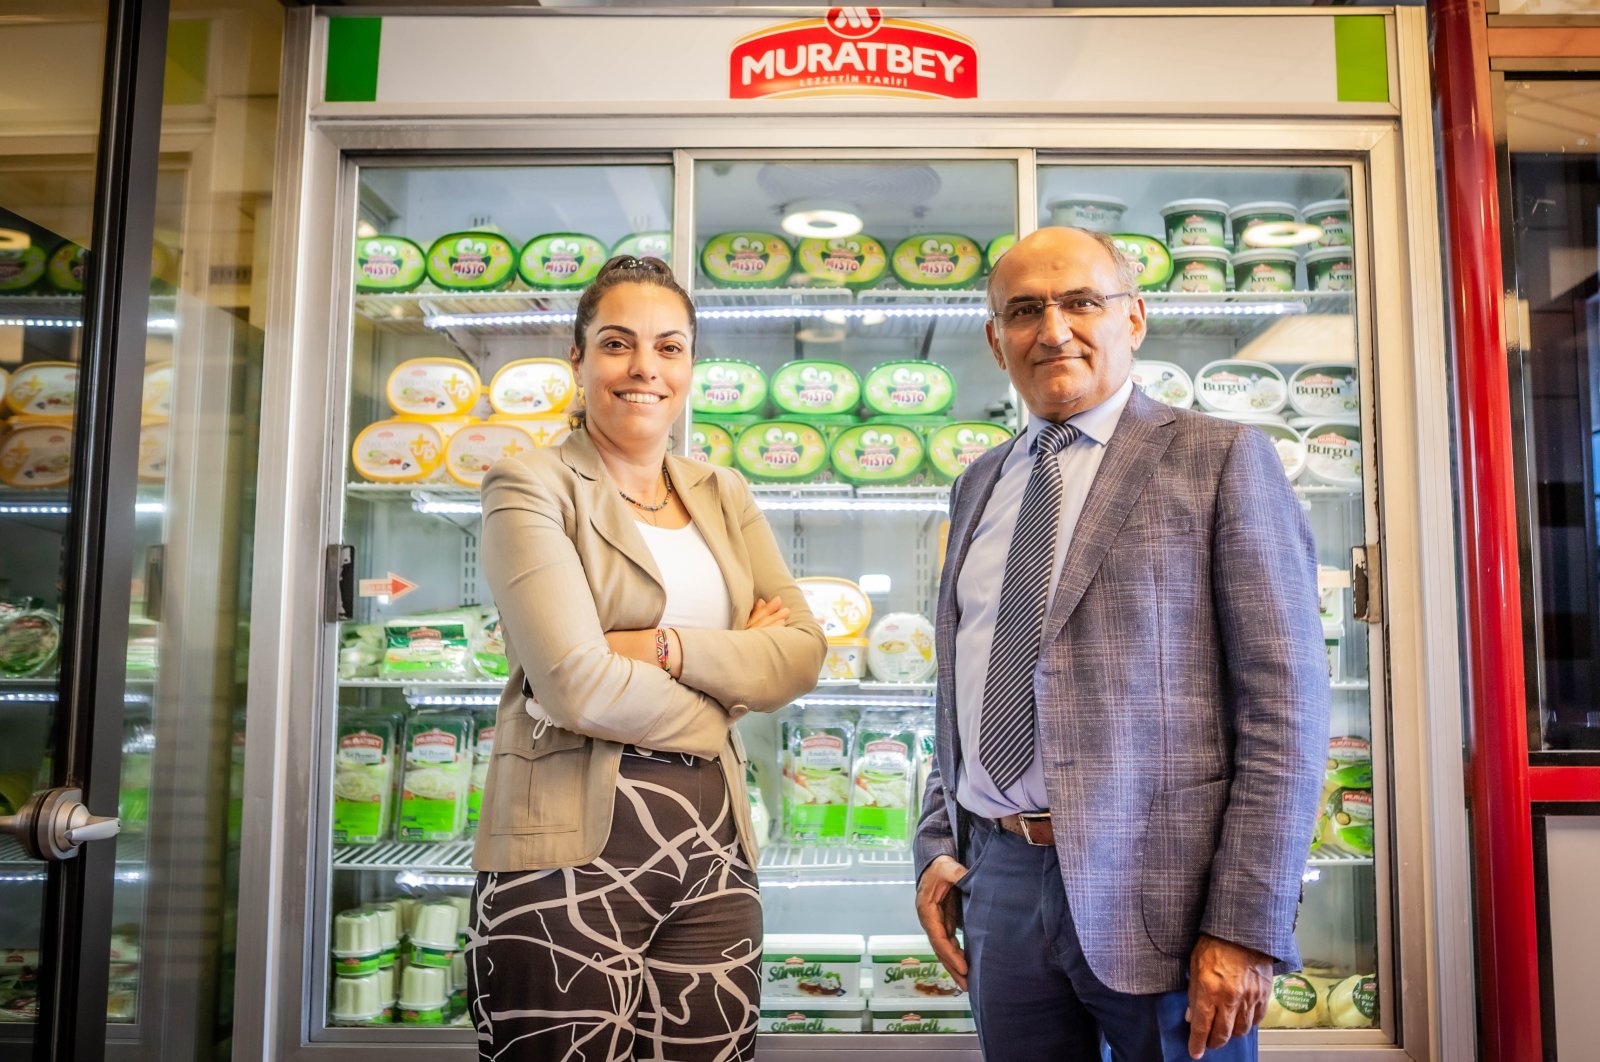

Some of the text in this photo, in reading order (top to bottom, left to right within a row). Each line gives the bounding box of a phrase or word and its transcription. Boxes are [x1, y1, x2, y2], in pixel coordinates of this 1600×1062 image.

[741, 41, 965, 86] MURATBEY
[799, 73, 908, 87] LEZZETİN TARİFİ
[1181, 224, 1208, 234] Krem
[1324, 227, 1344, 235] rem
[1182, 272, 1208, 281] Krem
[1251, 274, 1276, 283] Krem
[1203, 381, 1247, 395] Burgu
[1295, 385, 1341, 398] Burgu
[1307, 444, 1354, 460] Burgu
